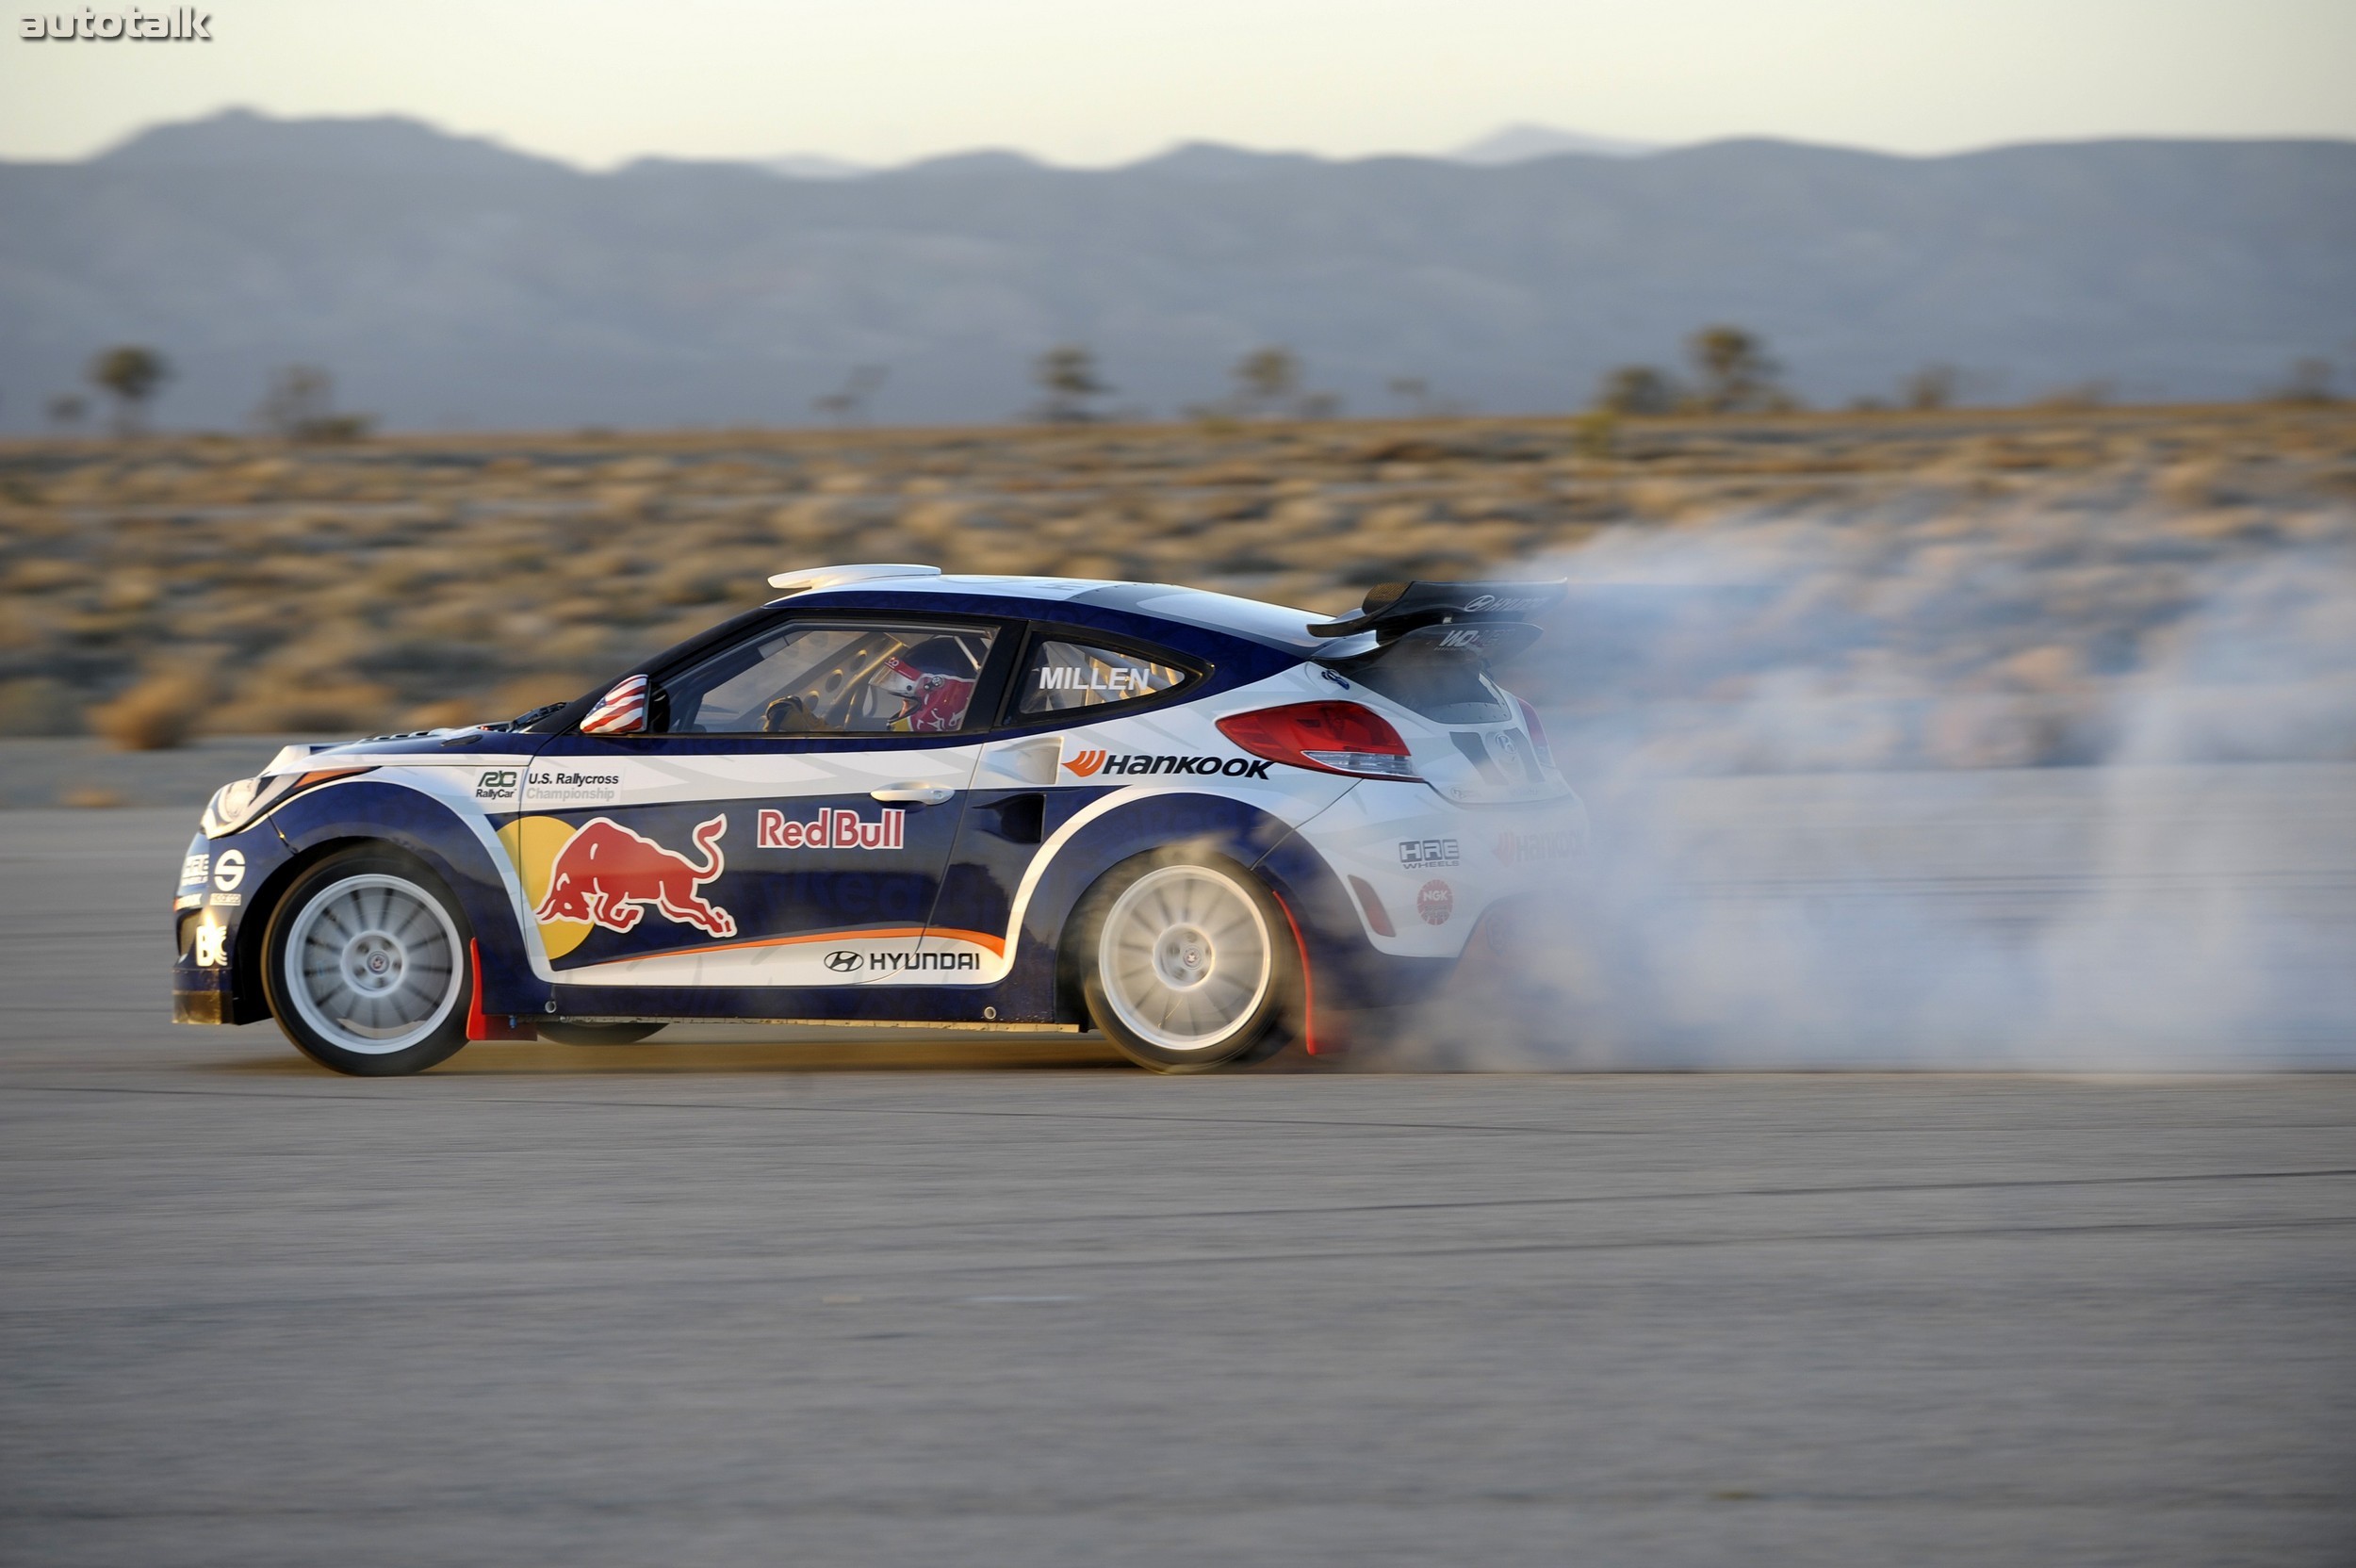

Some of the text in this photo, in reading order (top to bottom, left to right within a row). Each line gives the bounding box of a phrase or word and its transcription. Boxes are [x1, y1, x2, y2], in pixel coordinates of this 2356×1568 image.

[1039, 666, 1150, 691] MILLEN
[529, 773, 619, 787] U.S. Rallycross
[475, 789, 515, 800] RallyCar
[526, 788, 615, 802] Championship
[758, 808, 905, 849] Red Bull
[1399, 839, 1459, 863] HRE
[1402, 860, 1460, 870] WHEELS
[1423, 890, 1448, 902] NGK
[869, 953, 980, 971] HYUNDAI
